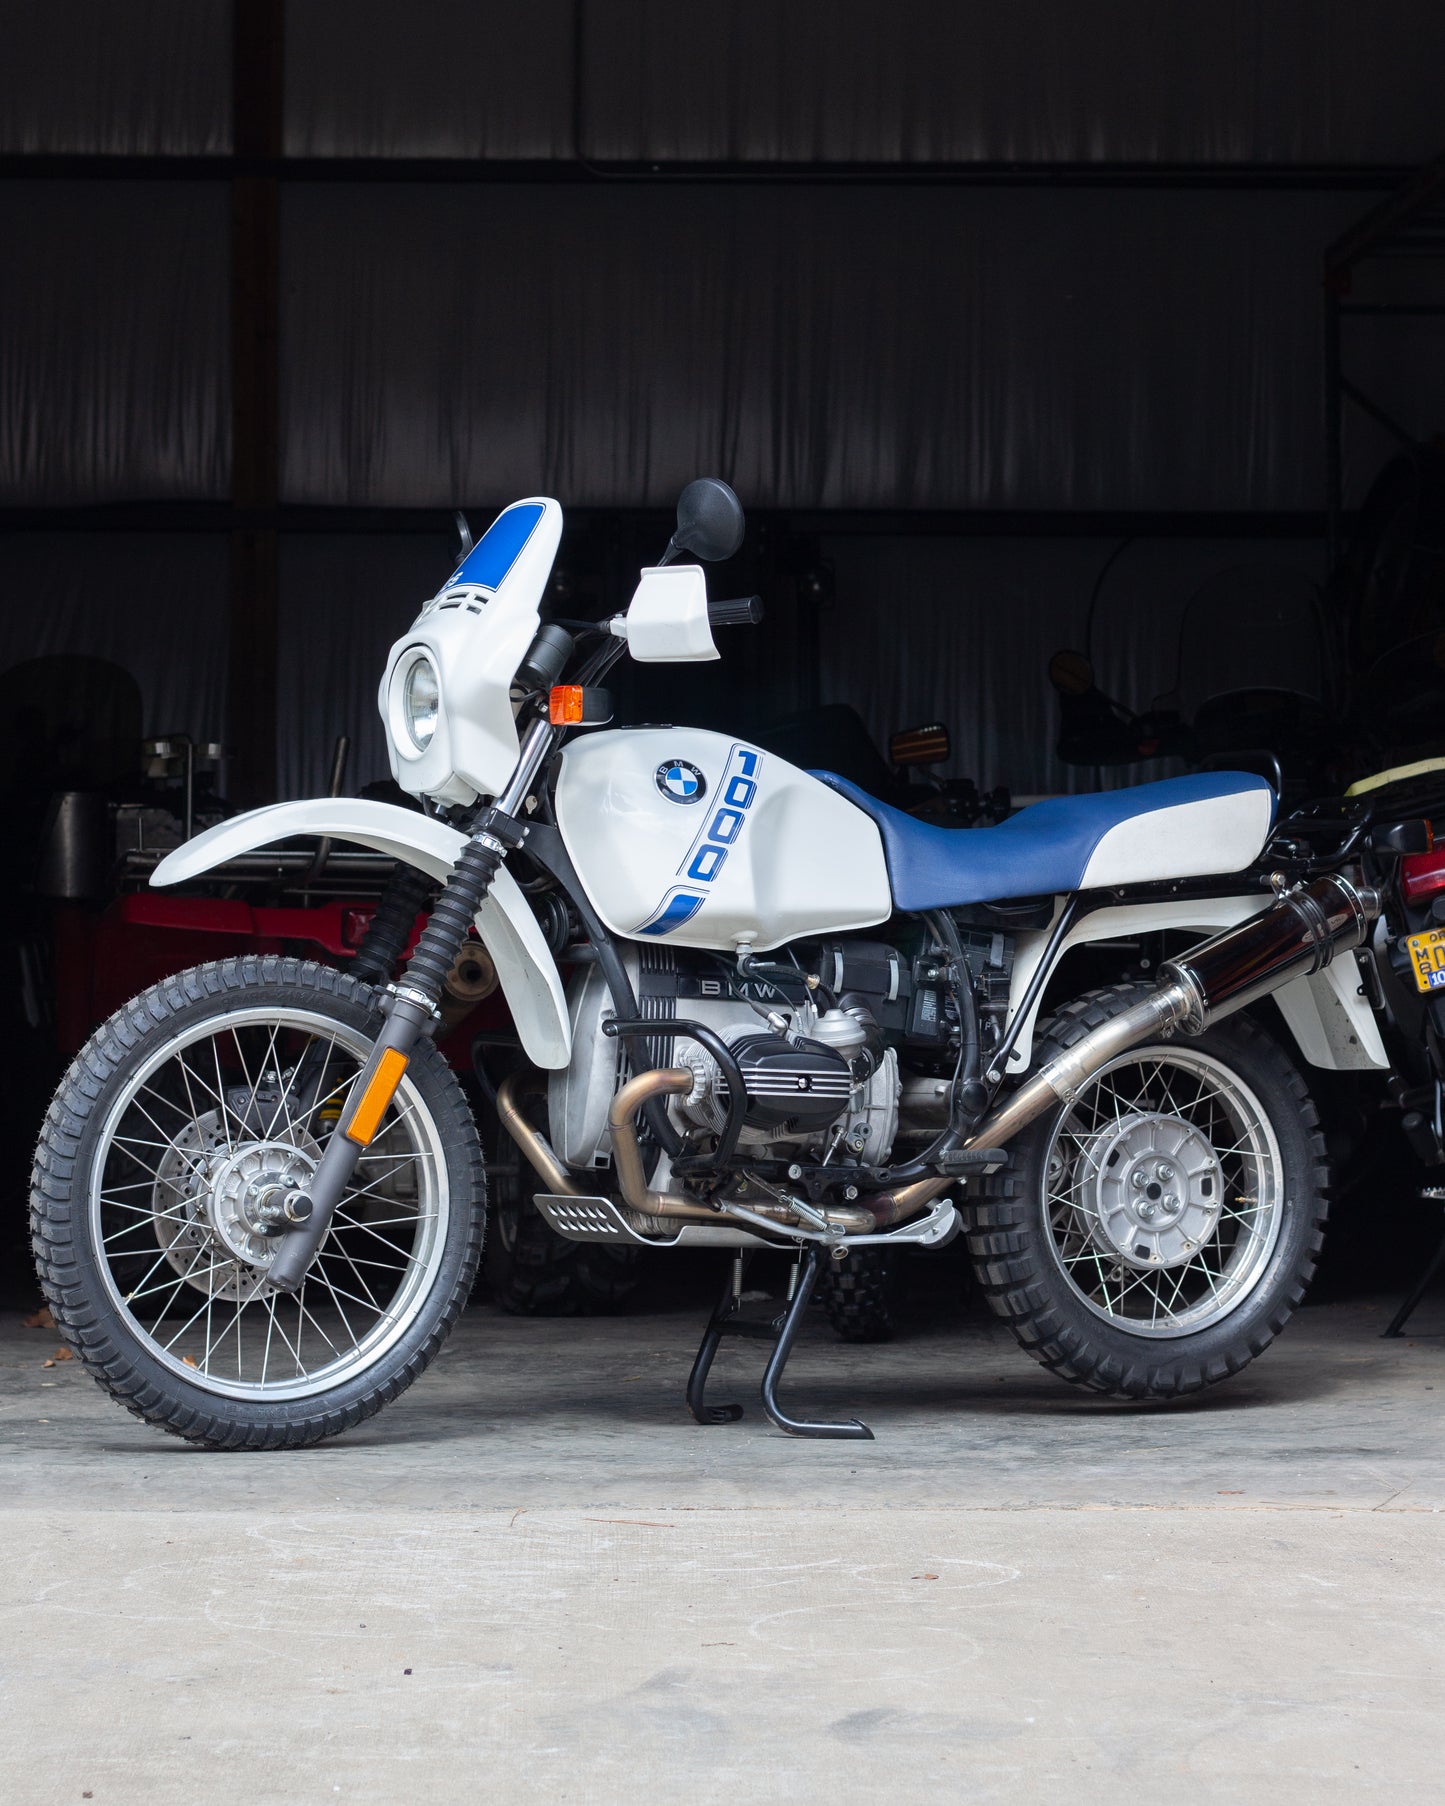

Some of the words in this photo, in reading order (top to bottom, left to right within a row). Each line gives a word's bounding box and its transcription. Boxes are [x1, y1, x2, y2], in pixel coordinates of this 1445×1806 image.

[658, 760, 702, 776] BMW
[683, 750, 758, 883] 1000
[701, 980, 775, 998] BMW
